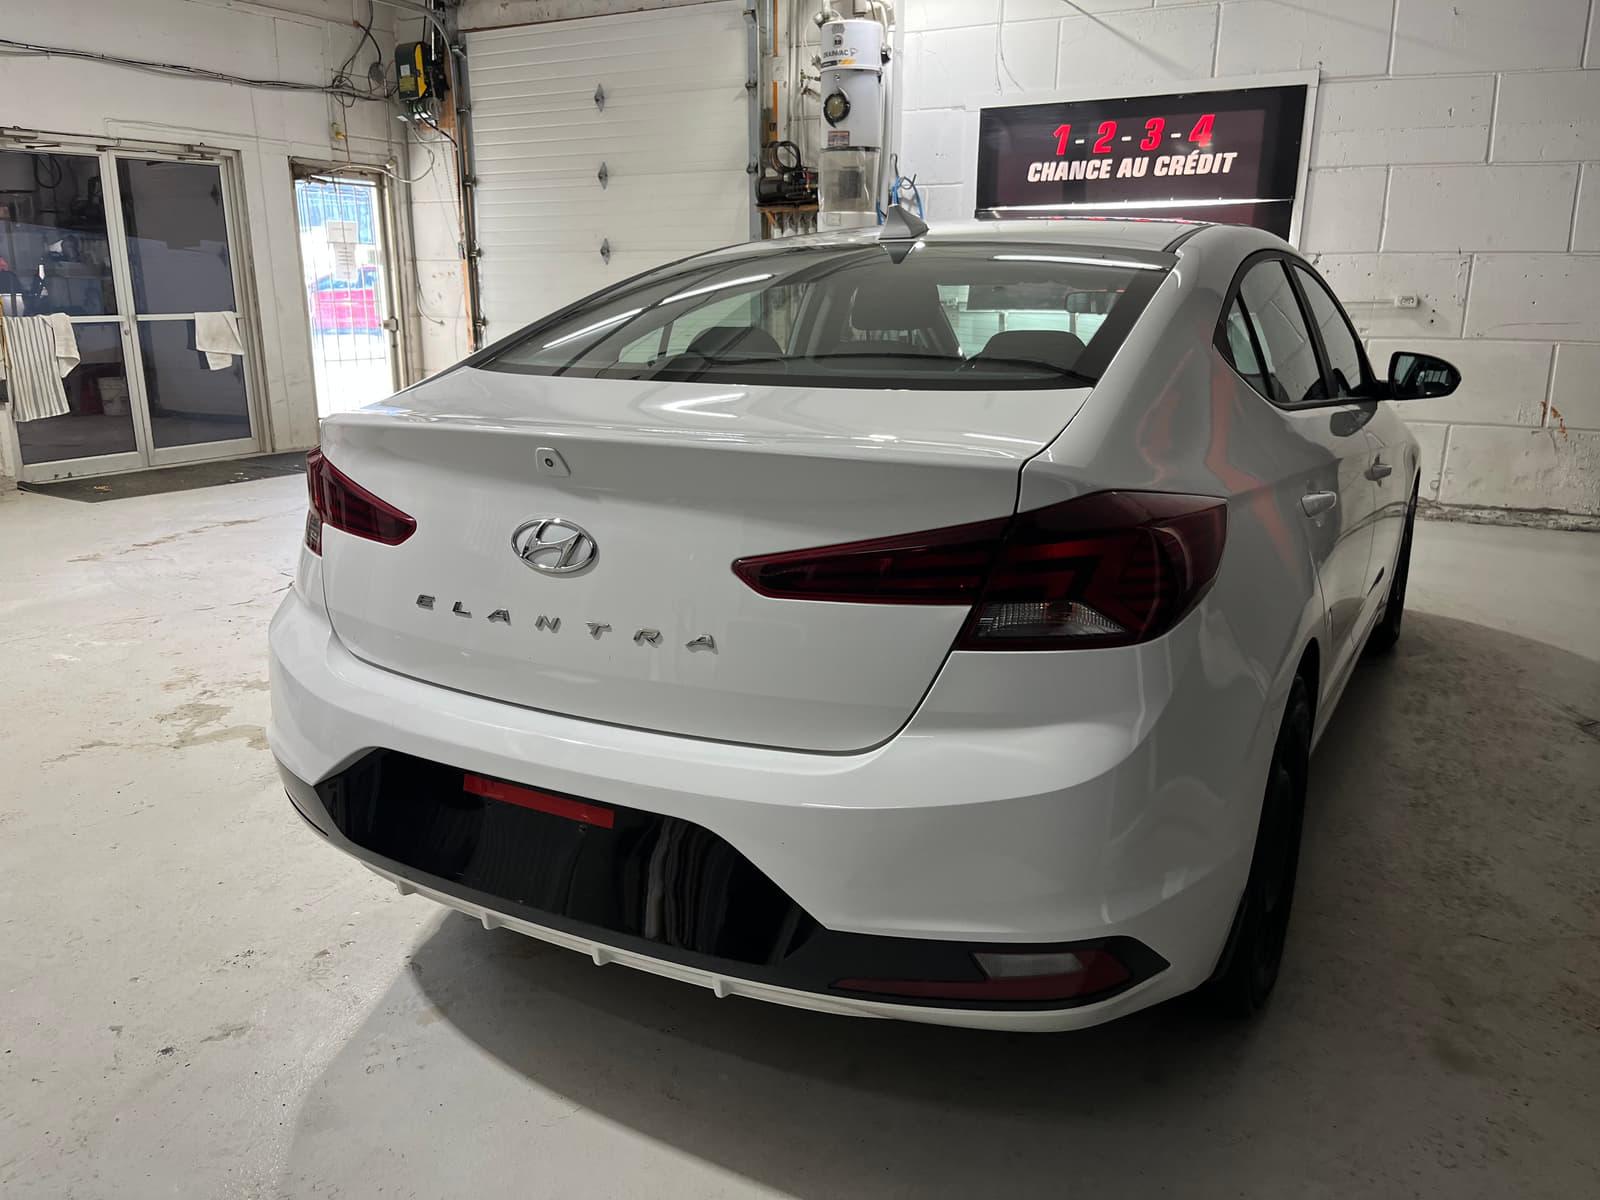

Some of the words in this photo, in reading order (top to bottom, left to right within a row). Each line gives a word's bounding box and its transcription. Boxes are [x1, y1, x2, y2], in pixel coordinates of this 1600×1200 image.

[1027, 159, 1113, 183] CHANCE
[1116, 156, 1150, 178] AU
[1153, 150, 1238, 177] CRÉDIT
[415, 594, 718, 654] ELANTRA
